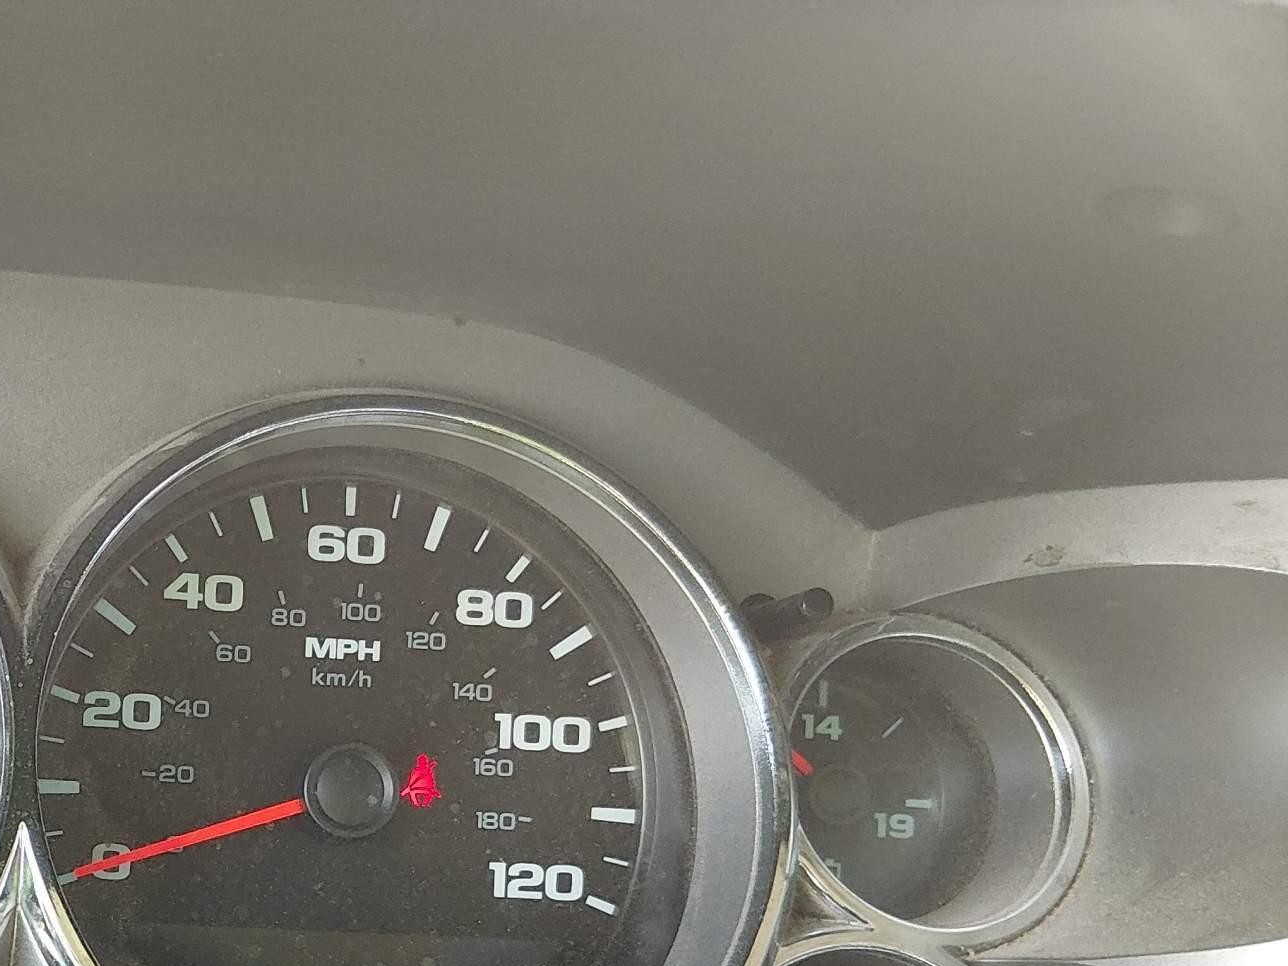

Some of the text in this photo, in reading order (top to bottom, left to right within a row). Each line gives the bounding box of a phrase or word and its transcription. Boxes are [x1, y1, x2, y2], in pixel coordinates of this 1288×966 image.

[307, 525, 385, 564] 60
[163, 572, 245, 612] 40
[271, 607, 306, 627] 80
[340, 602, 381, 622] 100
[455, 589, 533, 628] 80
[305, 636, 381, 662] MPH
[405, 631, 446, 651] 120
[215, 643, 252, 663] 60
[311, 667, 372, 689] km/h
[452, 682, 492, 702] 140
[82, 691, 162, 731] 20
[174, 699, 210, 719] 40
[495, 712, 591, 754] 100
[802, 714, 843, 741] 14
[158, 764, 195, 784] 20
[473, 758, 513, 778] 160
[476, 811, 516, 831] 180
[873, 812, 915, 839] 19
[489, 862, 583, 902] 120
